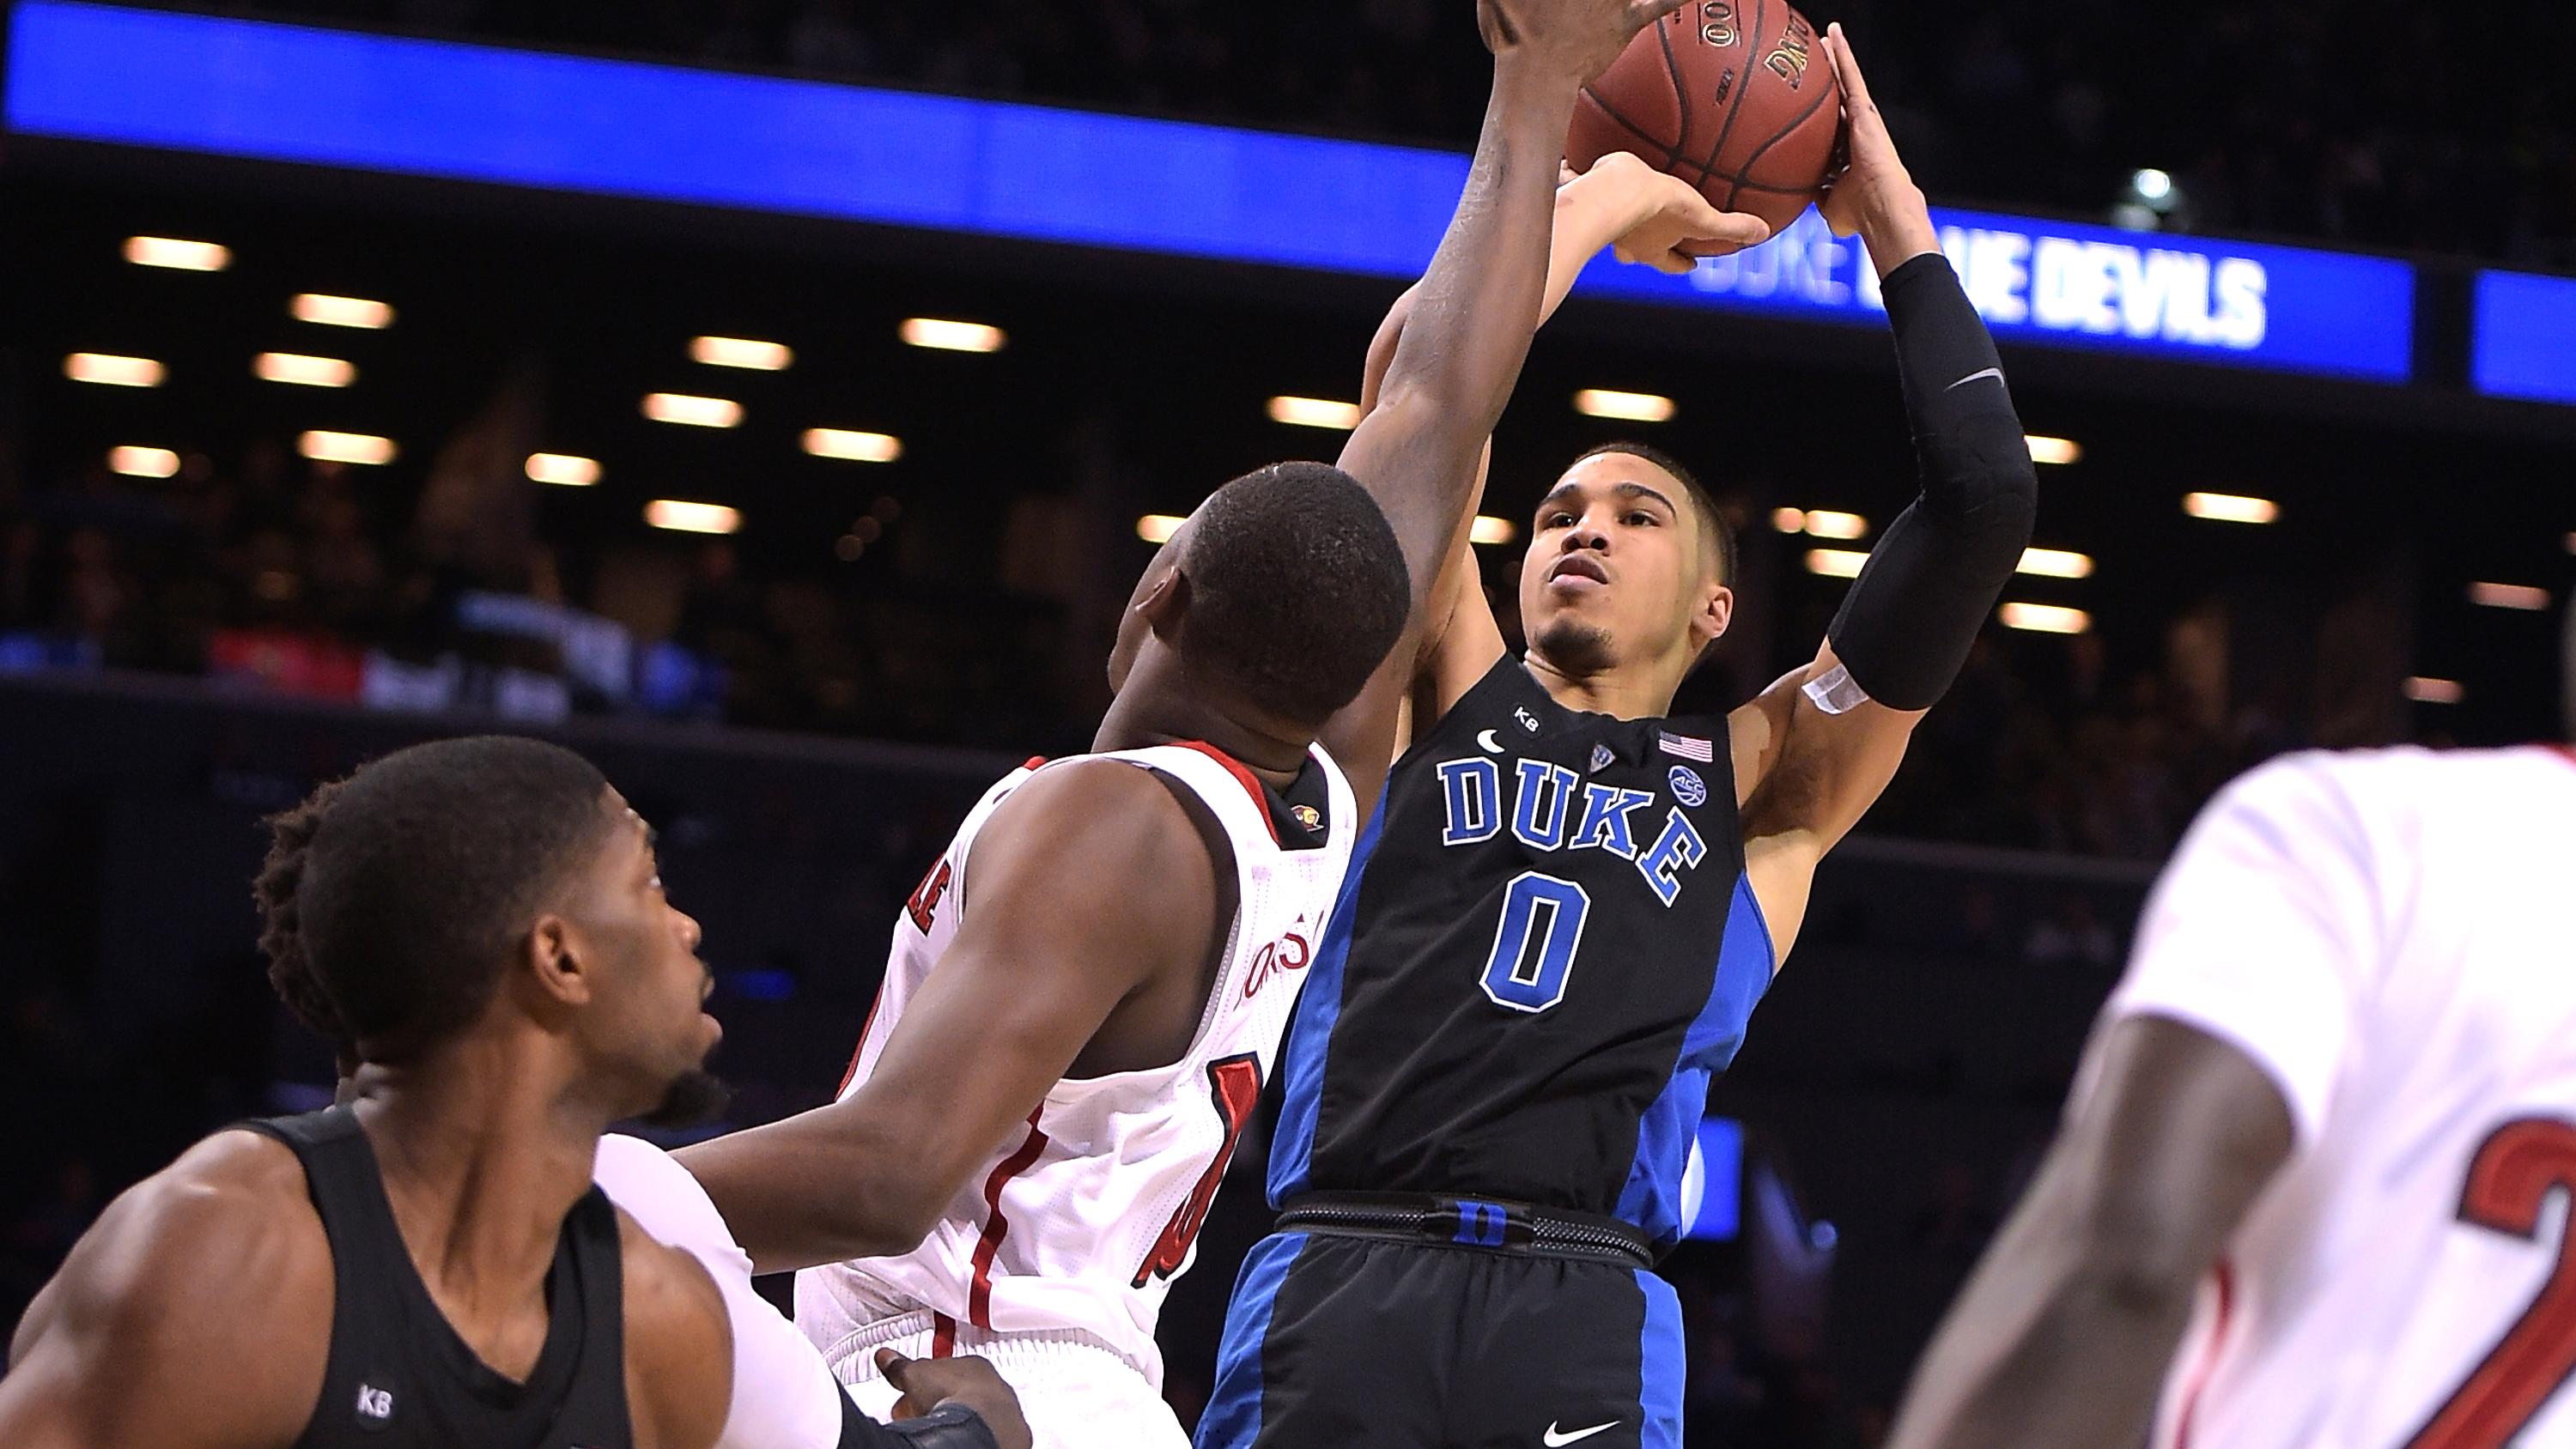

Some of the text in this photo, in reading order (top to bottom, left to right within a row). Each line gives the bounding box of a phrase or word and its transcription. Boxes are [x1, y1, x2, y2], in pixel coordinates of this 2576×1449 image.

[2032, 236, 2266, 349] DEVILS
[1514, 706, 1540, 733] KB
[1437, 756, 1708, 908] DUKE
[1479, 870, 1591, 1014] 0
[356, 1383, 393, 1419] KB
